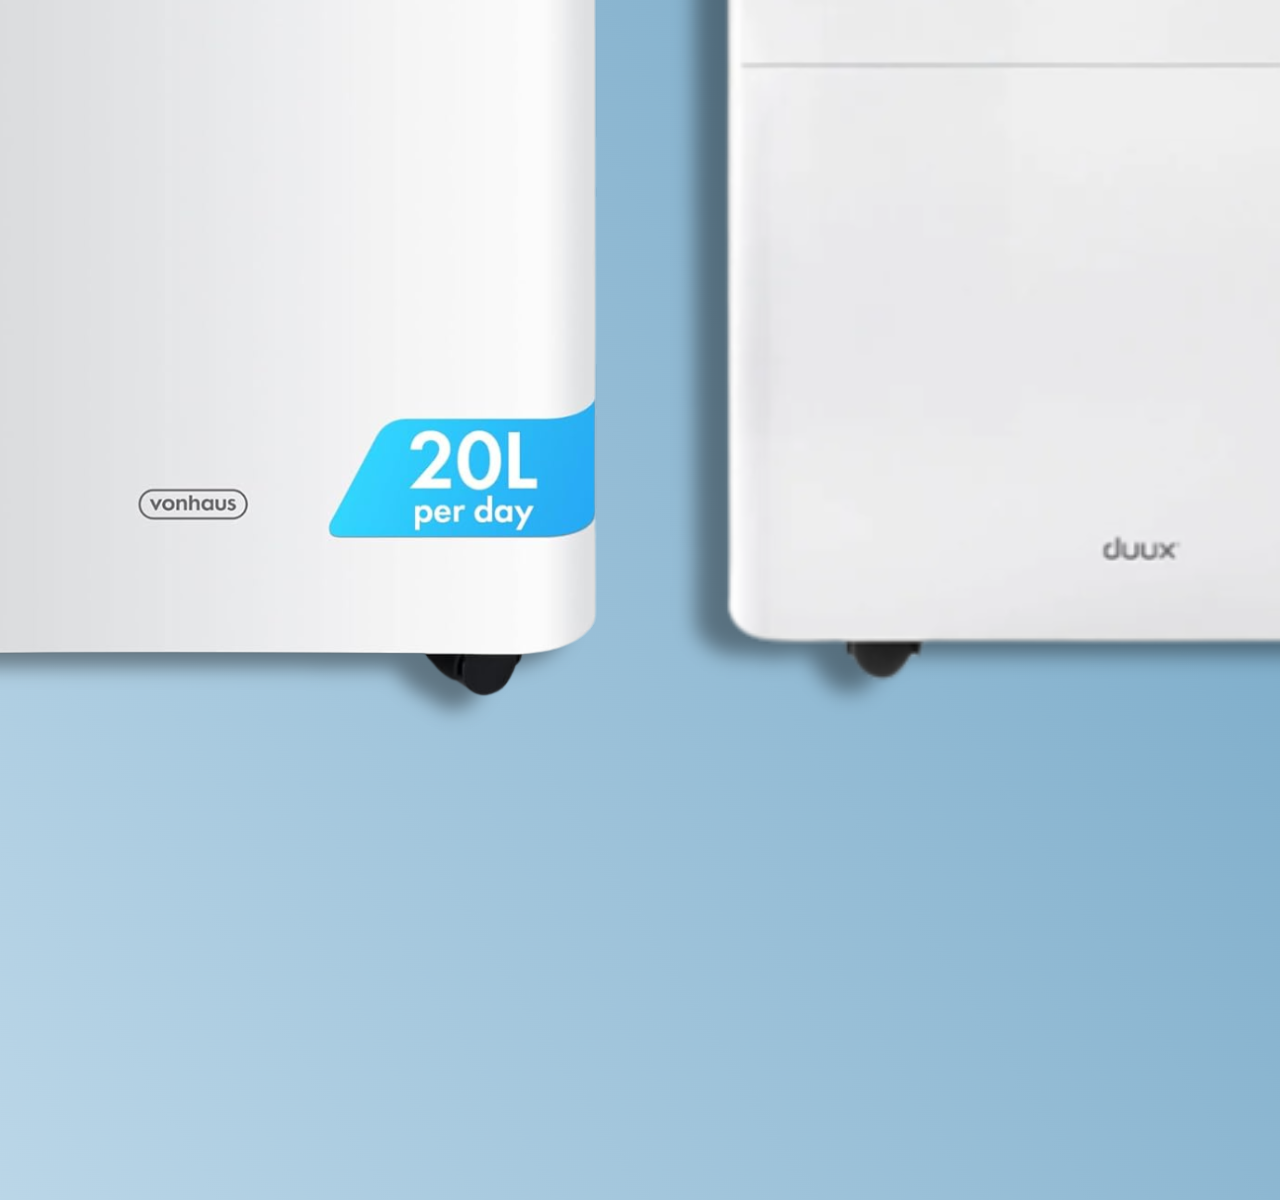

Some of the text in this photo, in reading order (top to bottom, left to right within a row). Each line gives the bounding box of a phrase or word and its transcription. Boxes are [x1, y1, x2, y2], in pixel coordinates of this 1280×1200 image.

[410, 430, 538, 491] 20L
[149, 494, 237, 512] vonhaus
[414, 495, 534, 531] per day
[1102, 536, 1177, 561] duux
